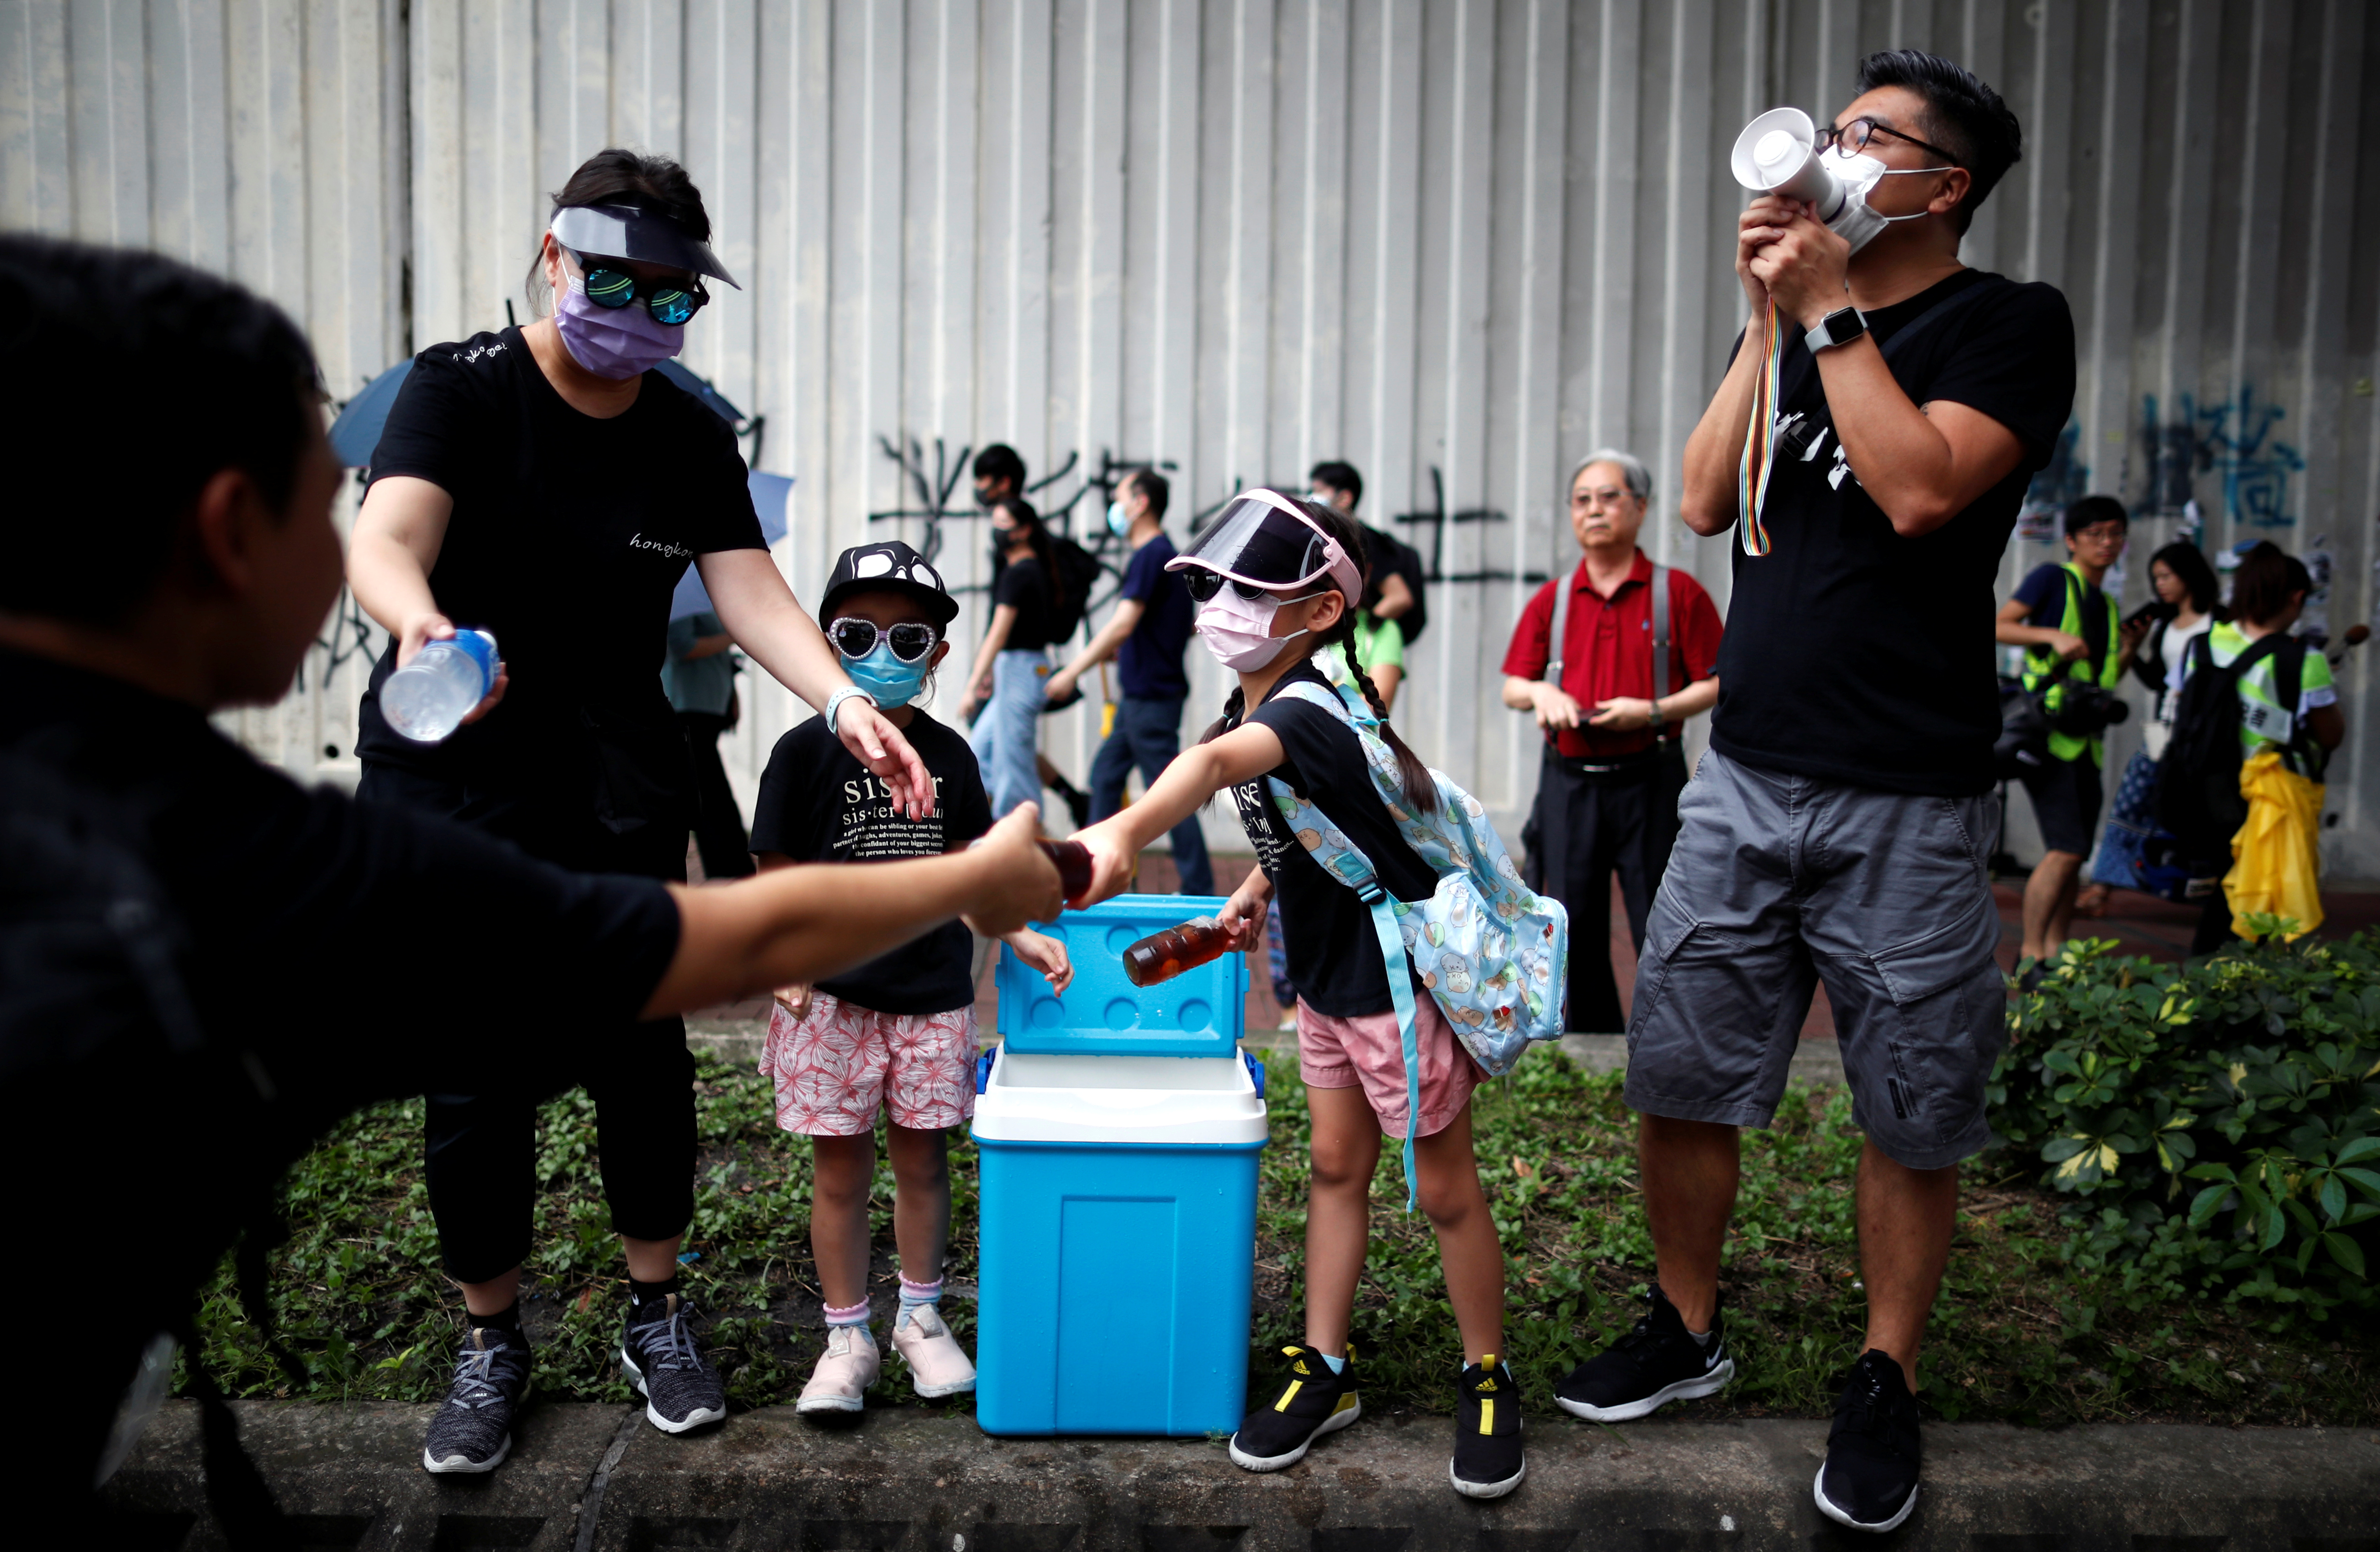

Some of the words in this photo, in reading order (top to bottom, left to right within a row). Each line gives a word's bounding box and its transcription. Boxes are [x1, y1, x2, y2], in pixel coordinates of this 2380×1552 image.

[844, 768, 943, 804] sisr
[848, 828, 856, 837] girl
[833, 838, 853, 849] partner
